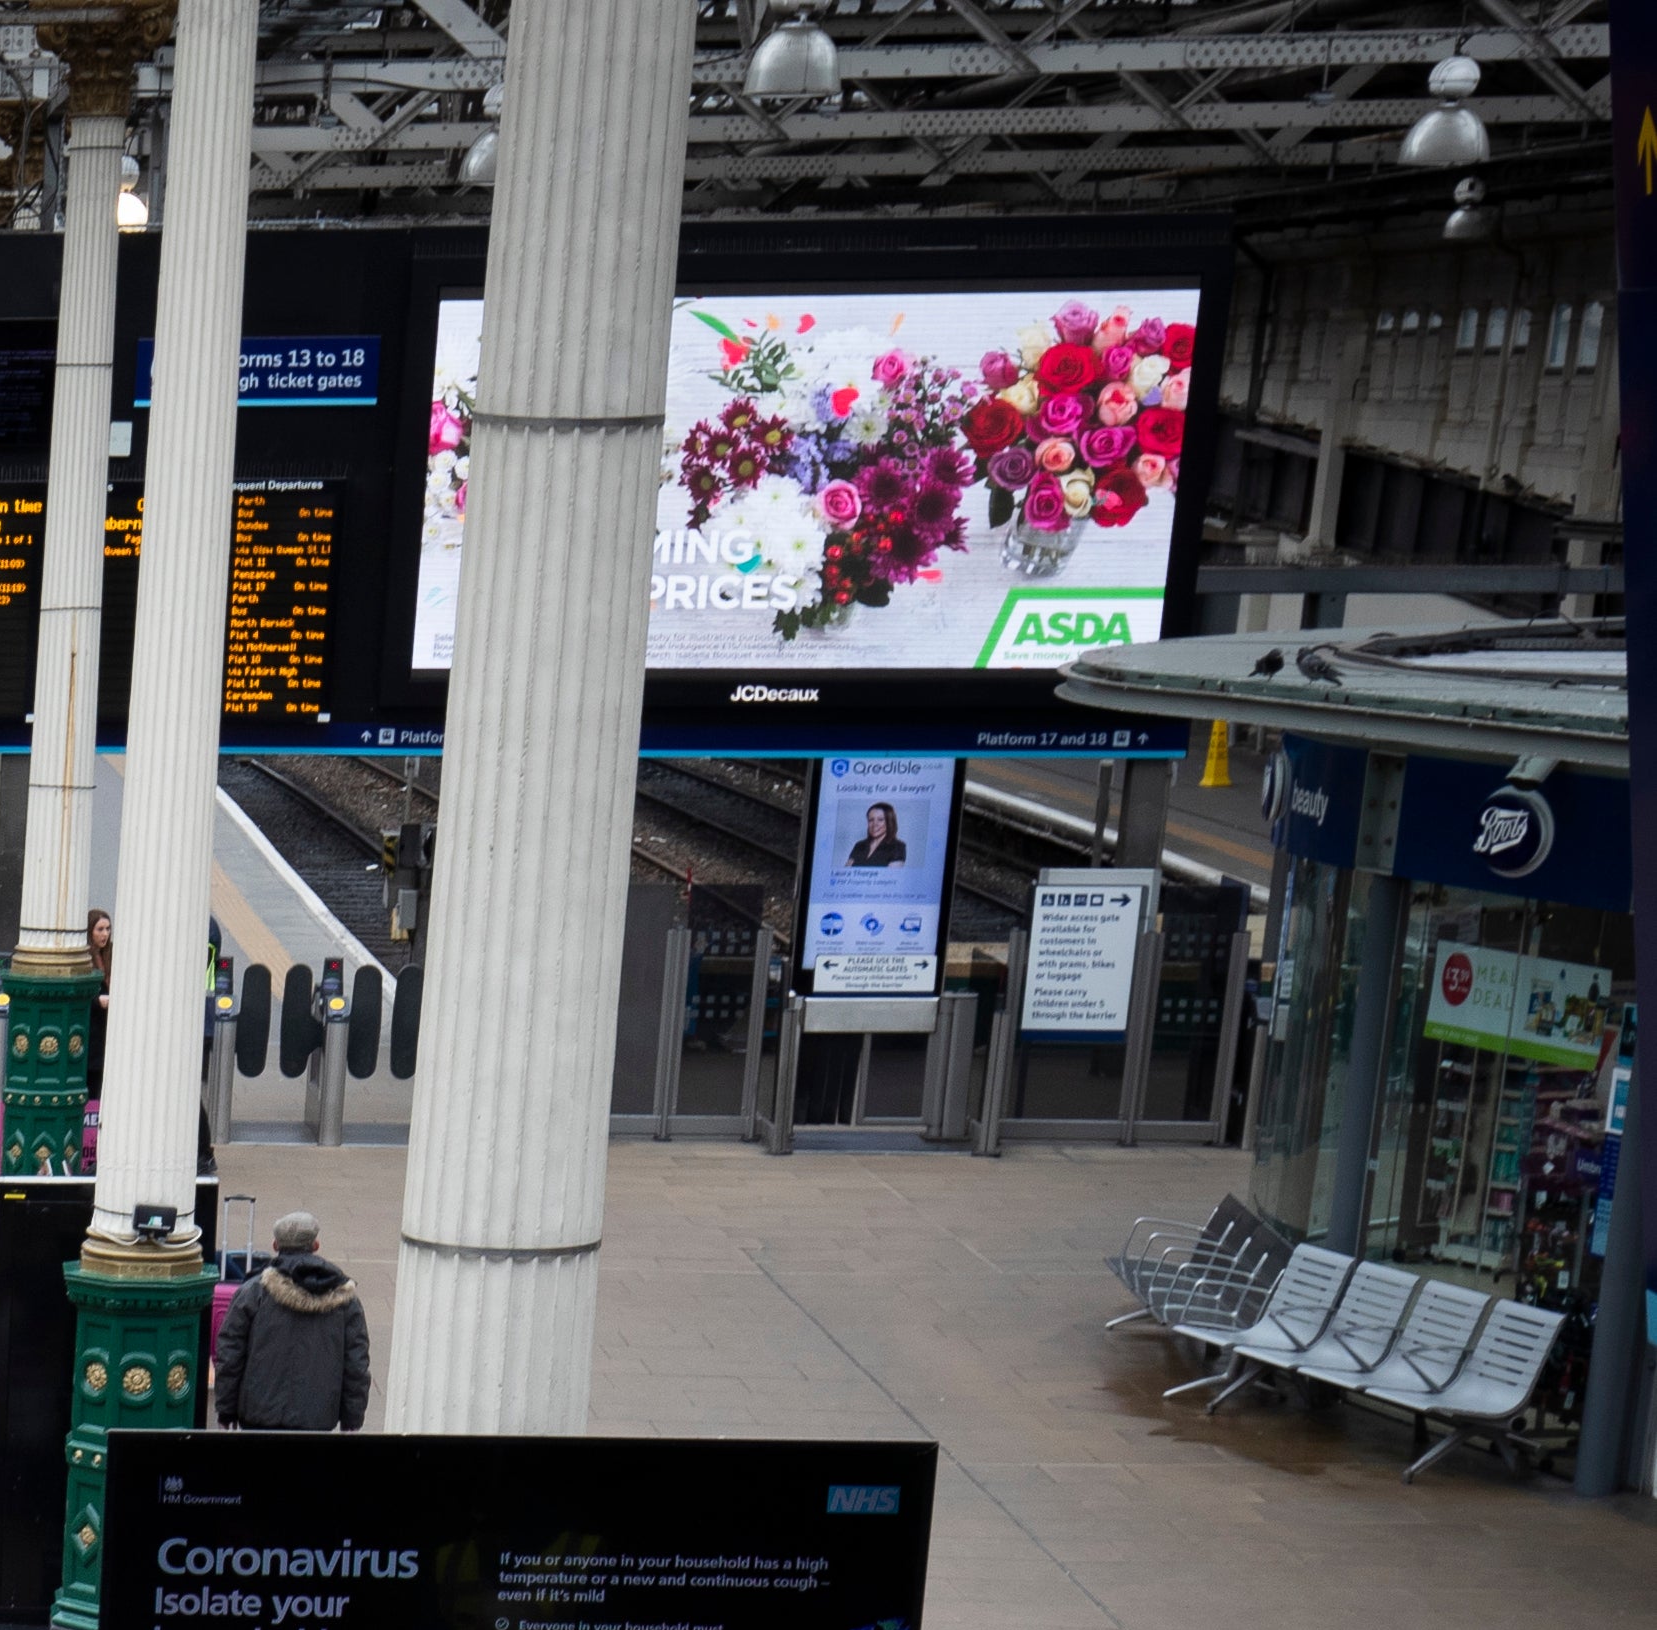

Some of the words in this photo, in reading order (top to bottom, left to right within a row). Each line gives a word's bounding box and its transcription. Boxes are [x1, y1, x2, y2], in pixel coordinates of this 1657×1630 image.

[288, 349, 311, 367] 13
[316, 351, 336, 367] to
[342, 349, 365, 366] 18
[268, 373, 314, 388] ticket
[318, 375, 362, 391] gates
[1013, 612, 1133, 646] ASDA
[730, 685, 819, 702] JCDecaux
[977, 732, 1036, 746] Platform
[1040, 732, 1056, 745] 17
[1061, 732, 1086, 745] and
[1089, 732, 1107, 745] 18
[853, 760, 921, 776] Qredible
[1291, 783, 1329, 826] beauty
[1473, 806, 1530, 855] Boots
[163, 1494, 180, 1504] HM
[183, 1494, 242, 1505] Government
[829, 1487, 899, 1512] NHS
[157, 1537, 419, 1579] Coronavirus
[499, 1552, 511, 1566] If
[514, 1555, 540, 1569] you
[544, 1555, 561, 1566] or
[564, 1555, 617, 1570] anyone
[621, 1555, 634, 1567] in
[638, 1556, 671, 1571] your
[675, 1554, 750, 1570] household
[754, 1556, 778, 1570] has
[783, 1559, 792, 1570] a
[796, 1557, 829, 1573] high
[155, 1586, 262, 1616] Isolate
[271, 1593, 349, 1625] your
